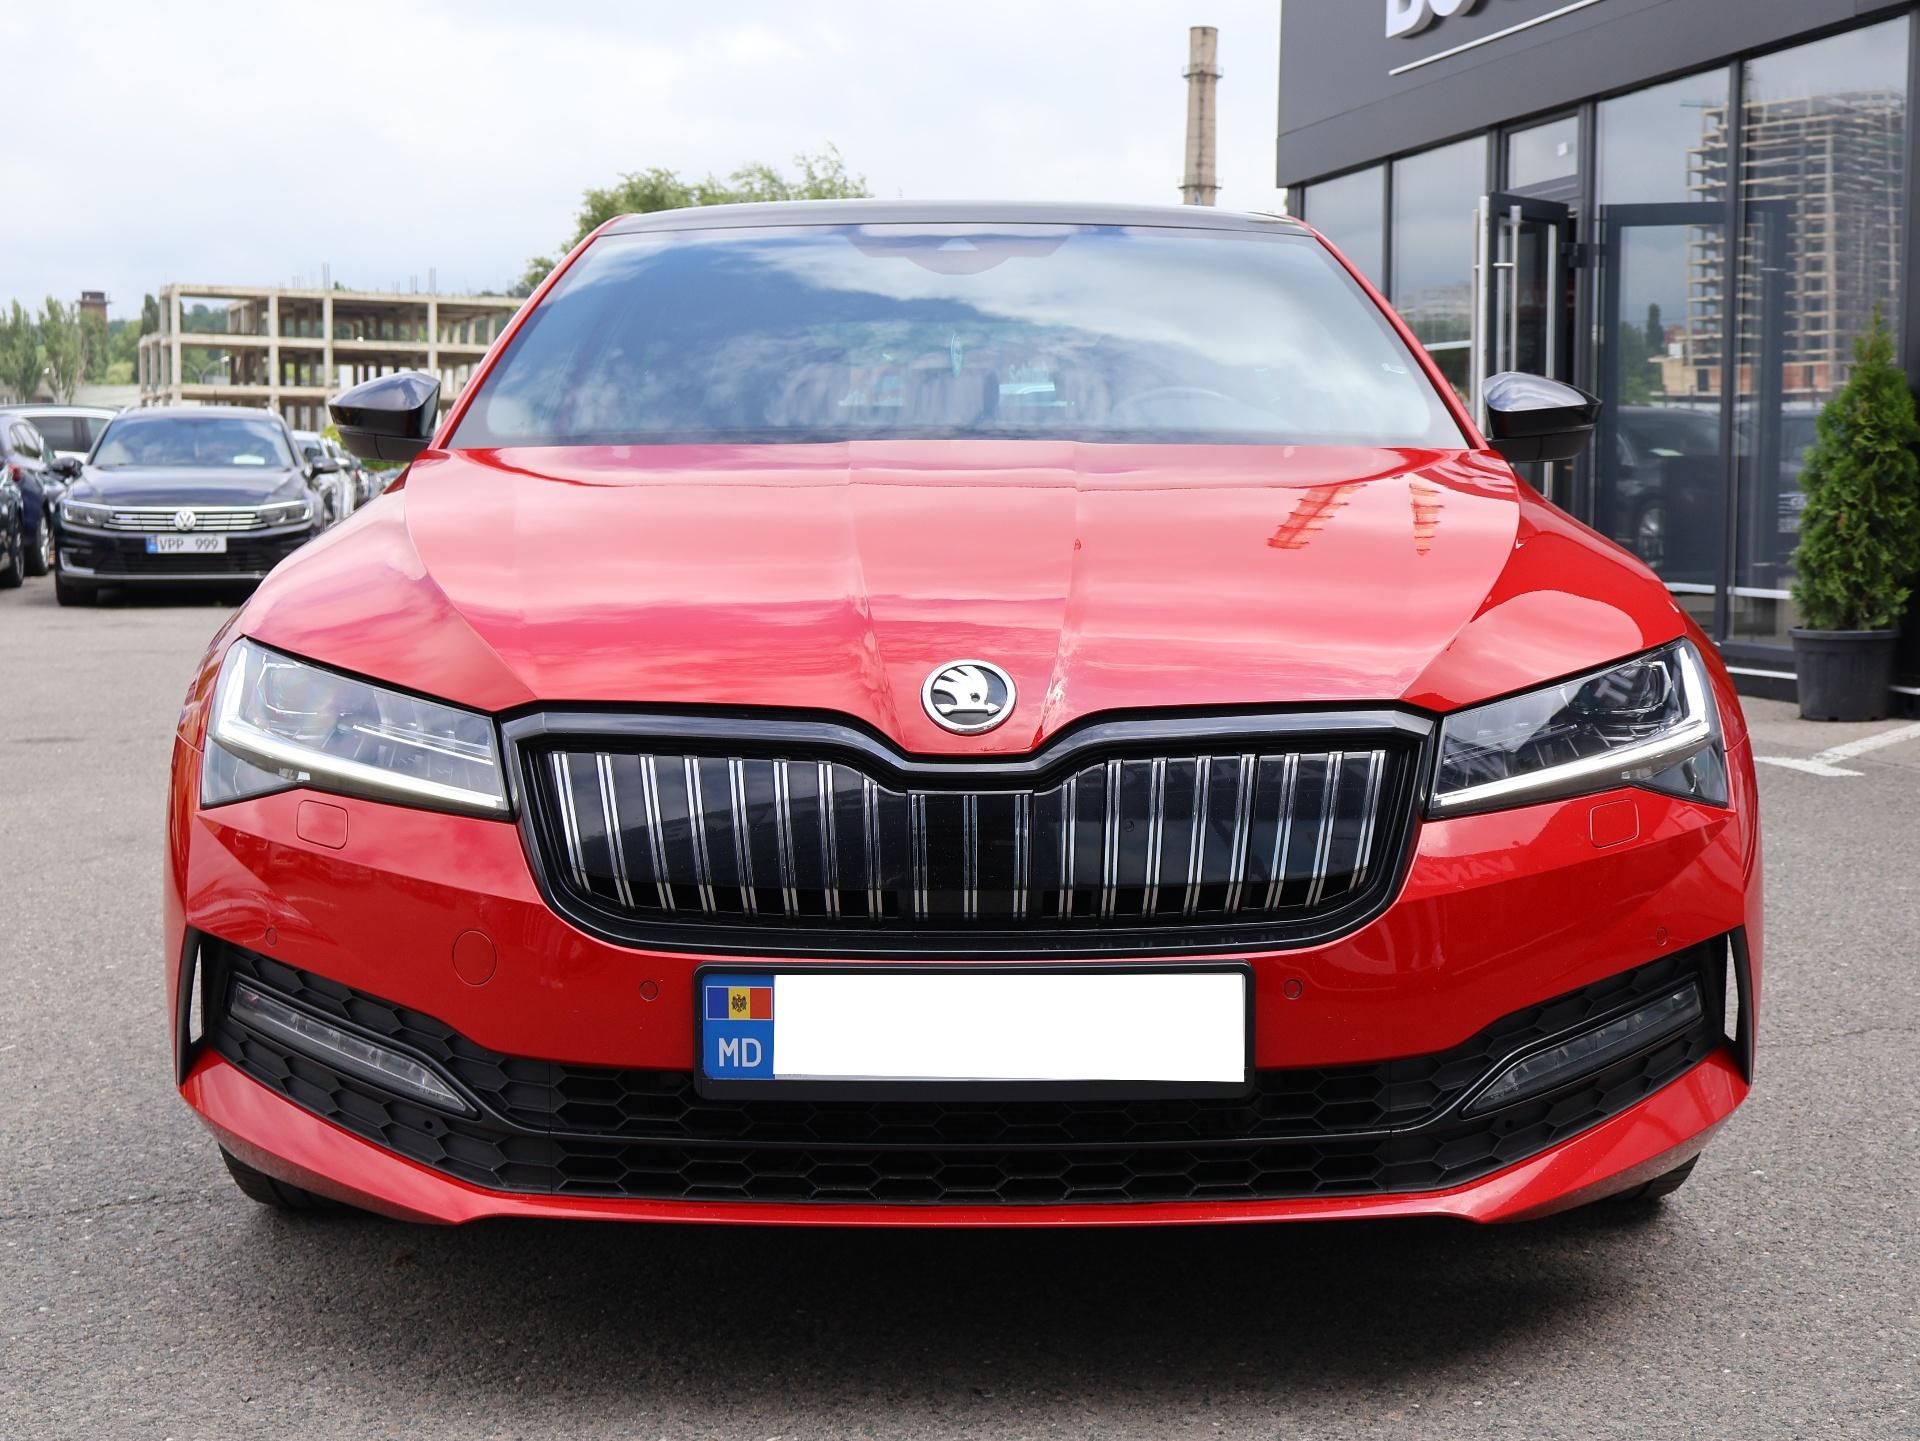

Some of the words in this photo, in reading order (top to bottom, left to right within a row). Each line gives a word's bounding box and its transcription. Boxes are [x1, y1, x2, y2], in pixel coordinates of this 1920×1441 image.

[160, 537, 184, 550] VPP
[195, 537, 218, 550] 999
[718, 1037, 762, 1067] MD
